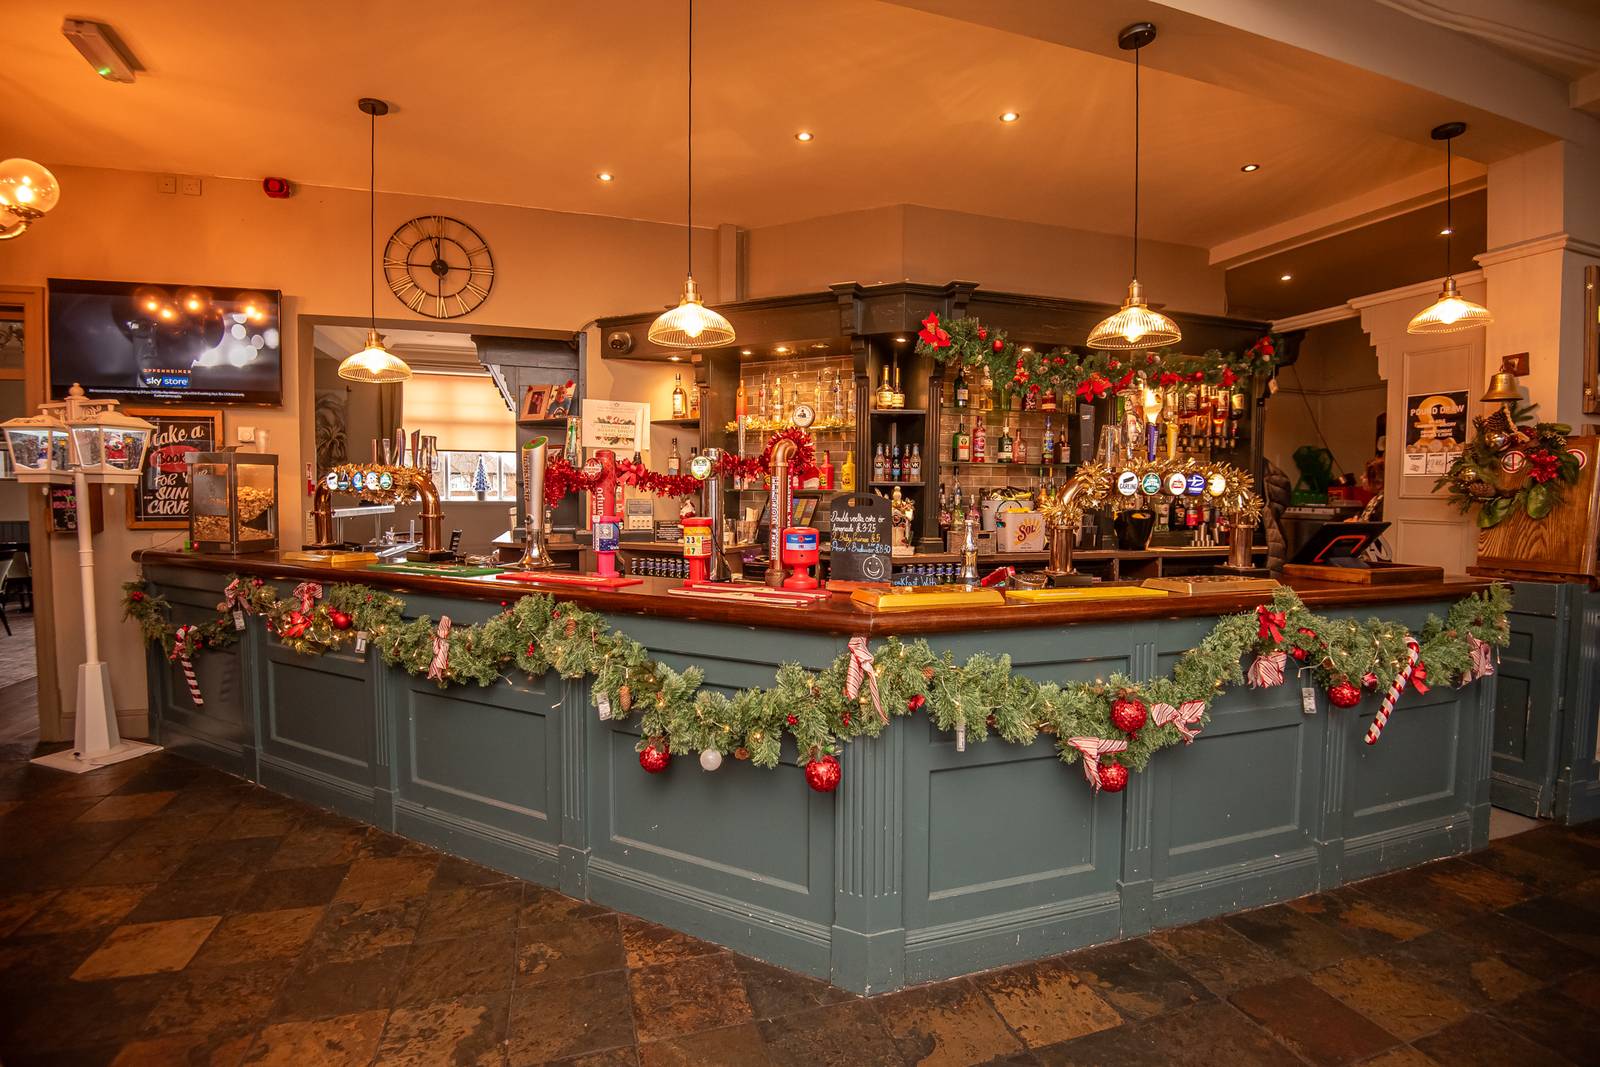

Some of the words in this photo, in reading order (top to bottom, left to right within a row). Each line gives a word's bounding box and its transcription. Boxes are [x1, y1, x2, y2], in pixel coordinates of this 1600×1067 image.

[146, 377, 162, 386] sky
[164, 377, 188, 386] store
[191, 425, 204, 439] a
[155, 472, 178, 487] FOR
[830, 510, 849, 522] Double
[850, 512, 865, 522] vodka
